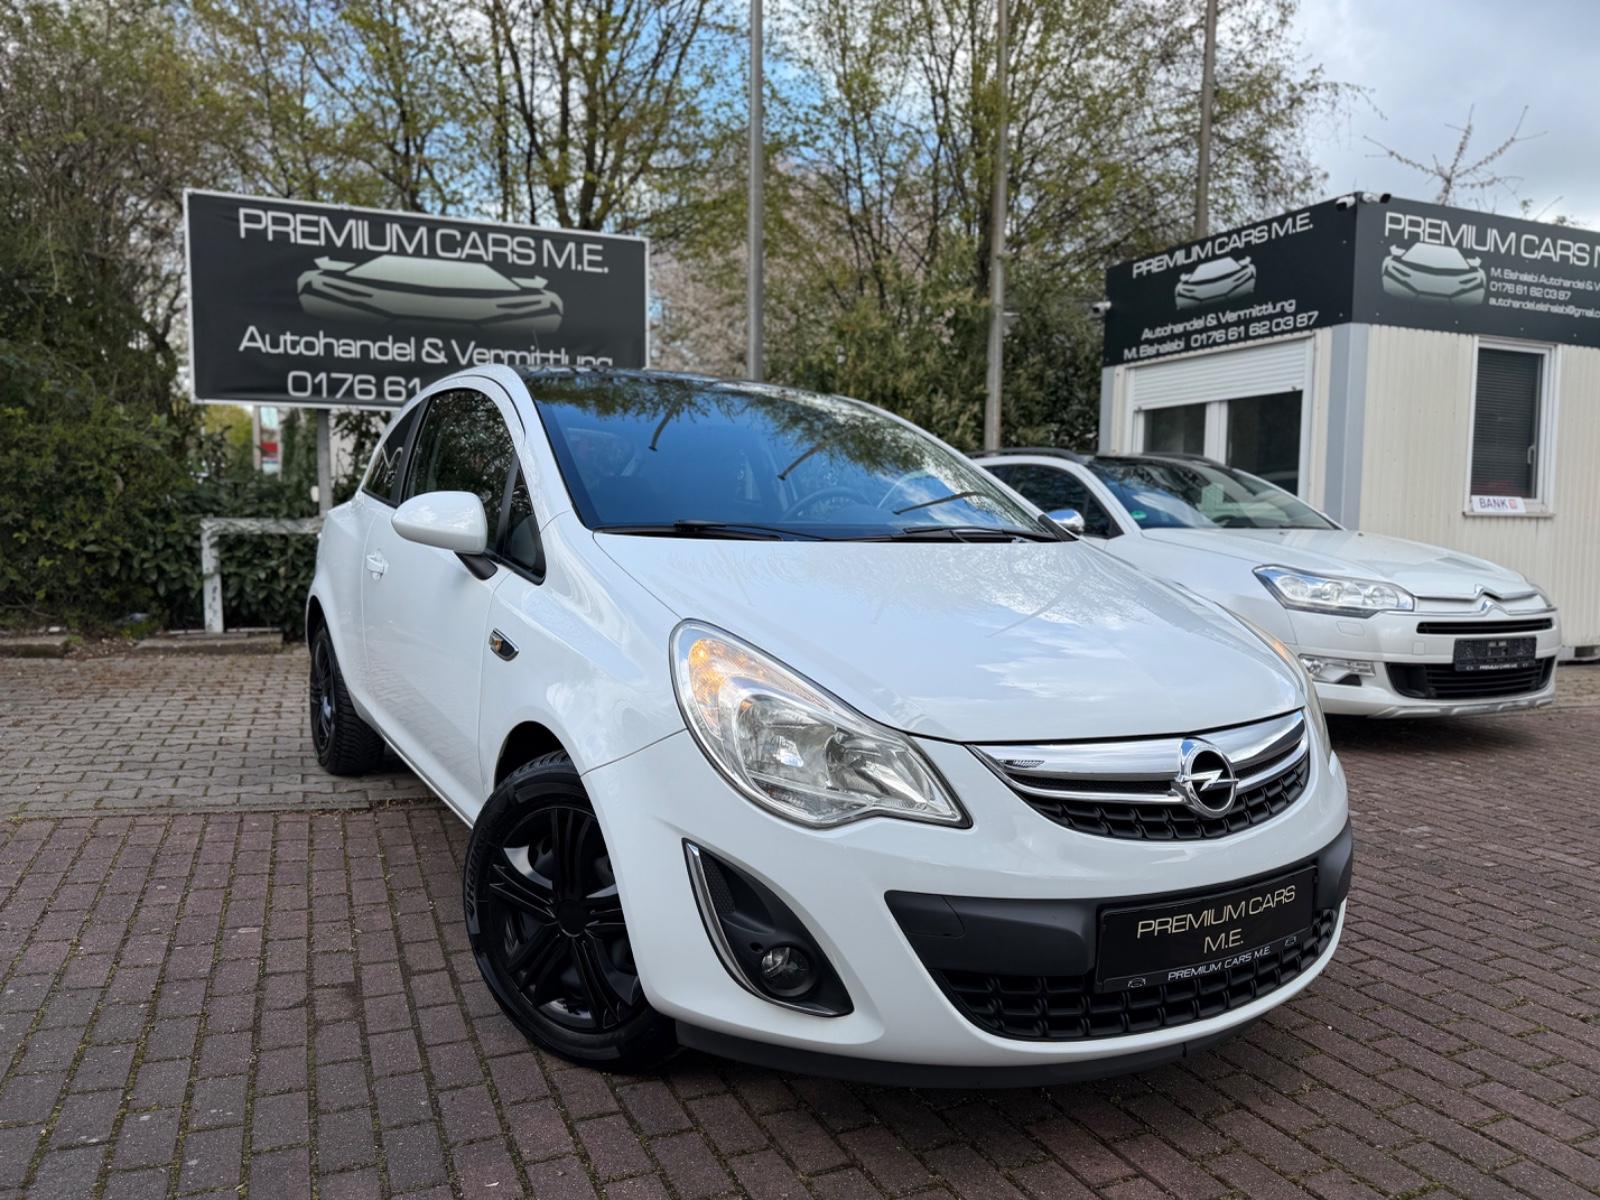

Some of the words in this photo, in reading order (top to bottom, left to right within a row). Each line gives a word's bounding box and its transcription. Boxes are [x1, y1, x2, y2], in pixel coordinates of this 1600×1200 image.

[238, 207, 428, 256] PREMIUM
[435, 228, 536, 266] CARS
[542, 241, 609, 274] M.E.
[1132, 242, 1213, 278] PREMIUM
[1214, 224, 1269, 255] CARS
[1271, 212, 1314, 241] M.E.
[1384, 212, 1516, 256] PREMIUM
[1520, 234, 1590, 267] CARS
[1489, 281, 1515, 294] 0176
[1515, 284, 1528, 295] 61
[1529, 287, 1543, 298] 62
[1543, 288, 1557, 299] 03
[1558, 291, 1572, 300] 87
[1539, 274, 1585, 290] Autohandel
[1123, 346, 1138, 361] M.
[1190, 330, 1226, 348] 0176
[1227, 325, 1245, 341] 61
[1248, 321, 1271, 336] 62
[1271, 317, 1294, 332] 03
[1296, 311, 1319, 327] 87
[1141, 314, 1205, 341] Autohandel
[1206, 313, 1218, 327] &
[1218, 299, 1297, 325] Vermittlung
[238, 326, 416, 362] Autohandel
[421, 338, 447, 364] &
[287, 371, 376, 400] 0176
[384, 376, 421, 401] 61
[1479, 497, 1508, 509] BANK
[1137, 901, 1246, 939] PREMIUM
[1249, 885, 1296, 915] CARS
[1203, 928, 1245, 954] M.E.
[1167, 961, 1222, 981] PREMIUM
[1224, 952, 1252, 969] CARS
